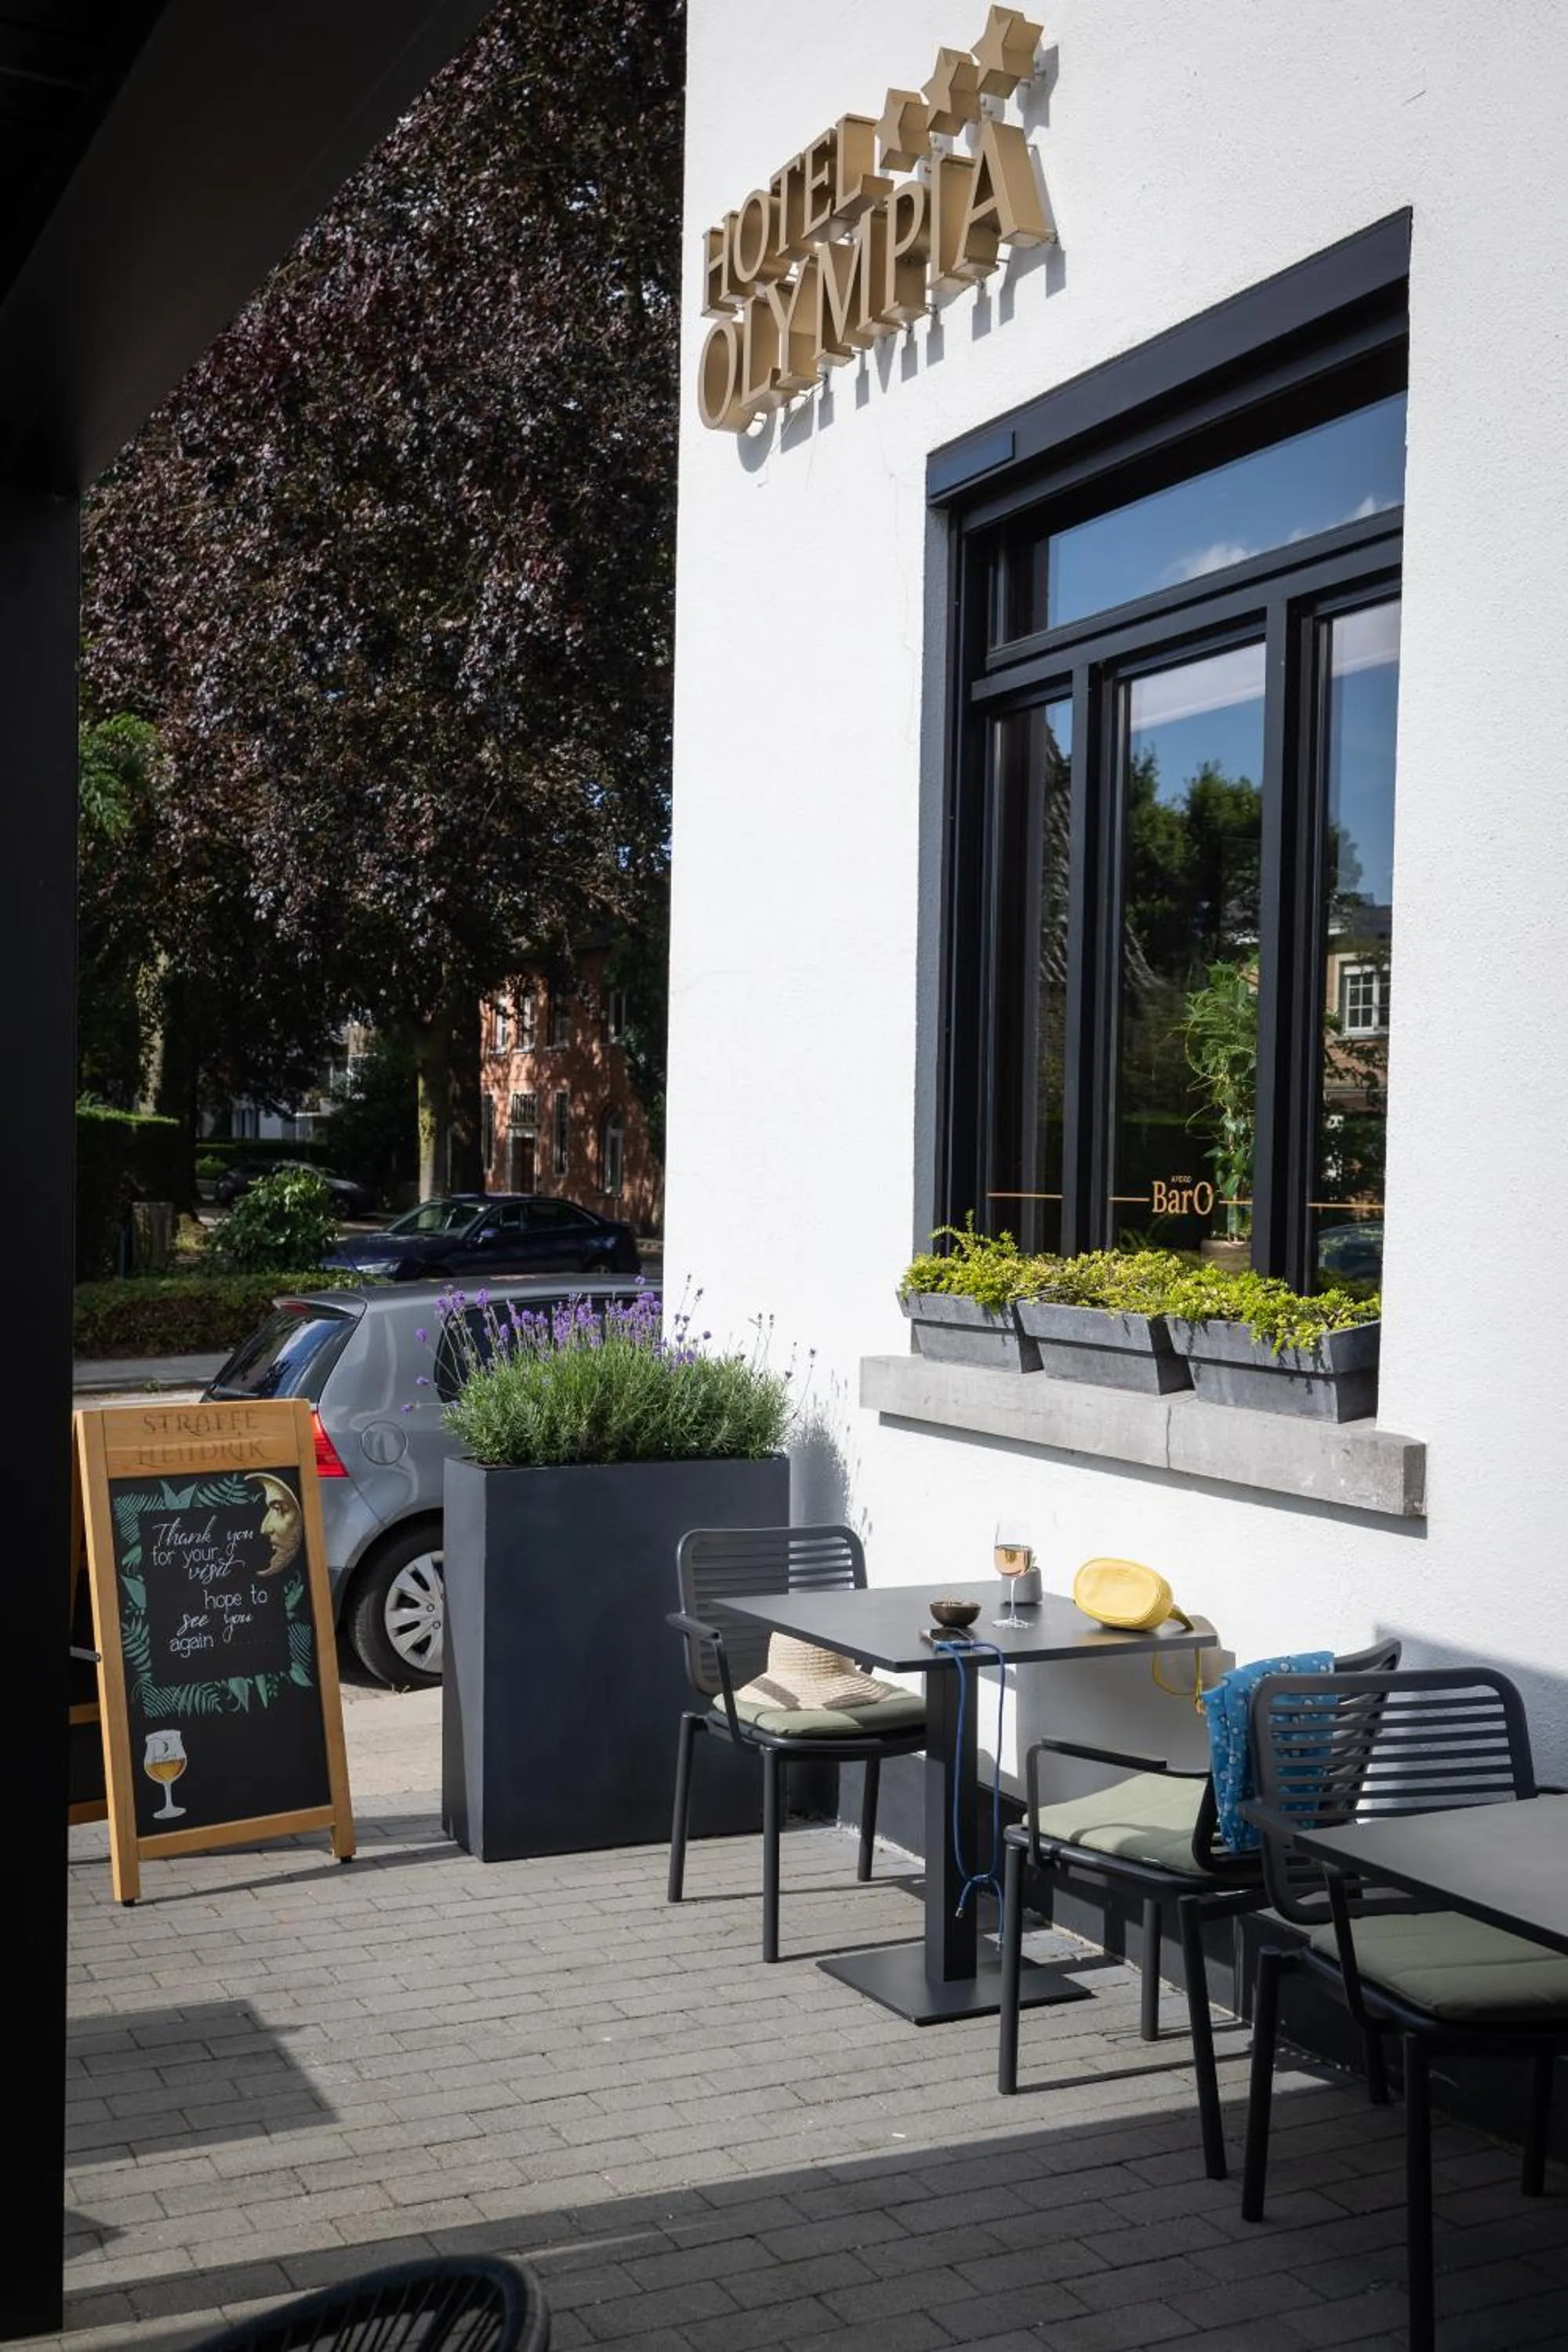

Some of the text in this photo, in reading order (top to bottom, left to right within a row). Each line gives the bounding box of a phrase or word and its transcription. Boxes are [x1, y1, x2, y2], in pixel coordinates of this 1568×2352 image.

[701, 113, 882, 318] HOTEL
[697, 120, 1043, 434] OLYMPIA
[1152, 1181, 1214, 1216] BarO
[143, 1409, 258, 1435] STRAFFE
[138, 1434, 274, 1468] HENDRIK
[152, 1515, 253, 1558] Thank you
[151, 1545, 219, 1568] for your
[188, 1559, 245, 1584] visit
[203, 1584, 267, 1613] hope to
[176, 1613, 252, 1643] see you
[169, 1633, 214, 1658] again
